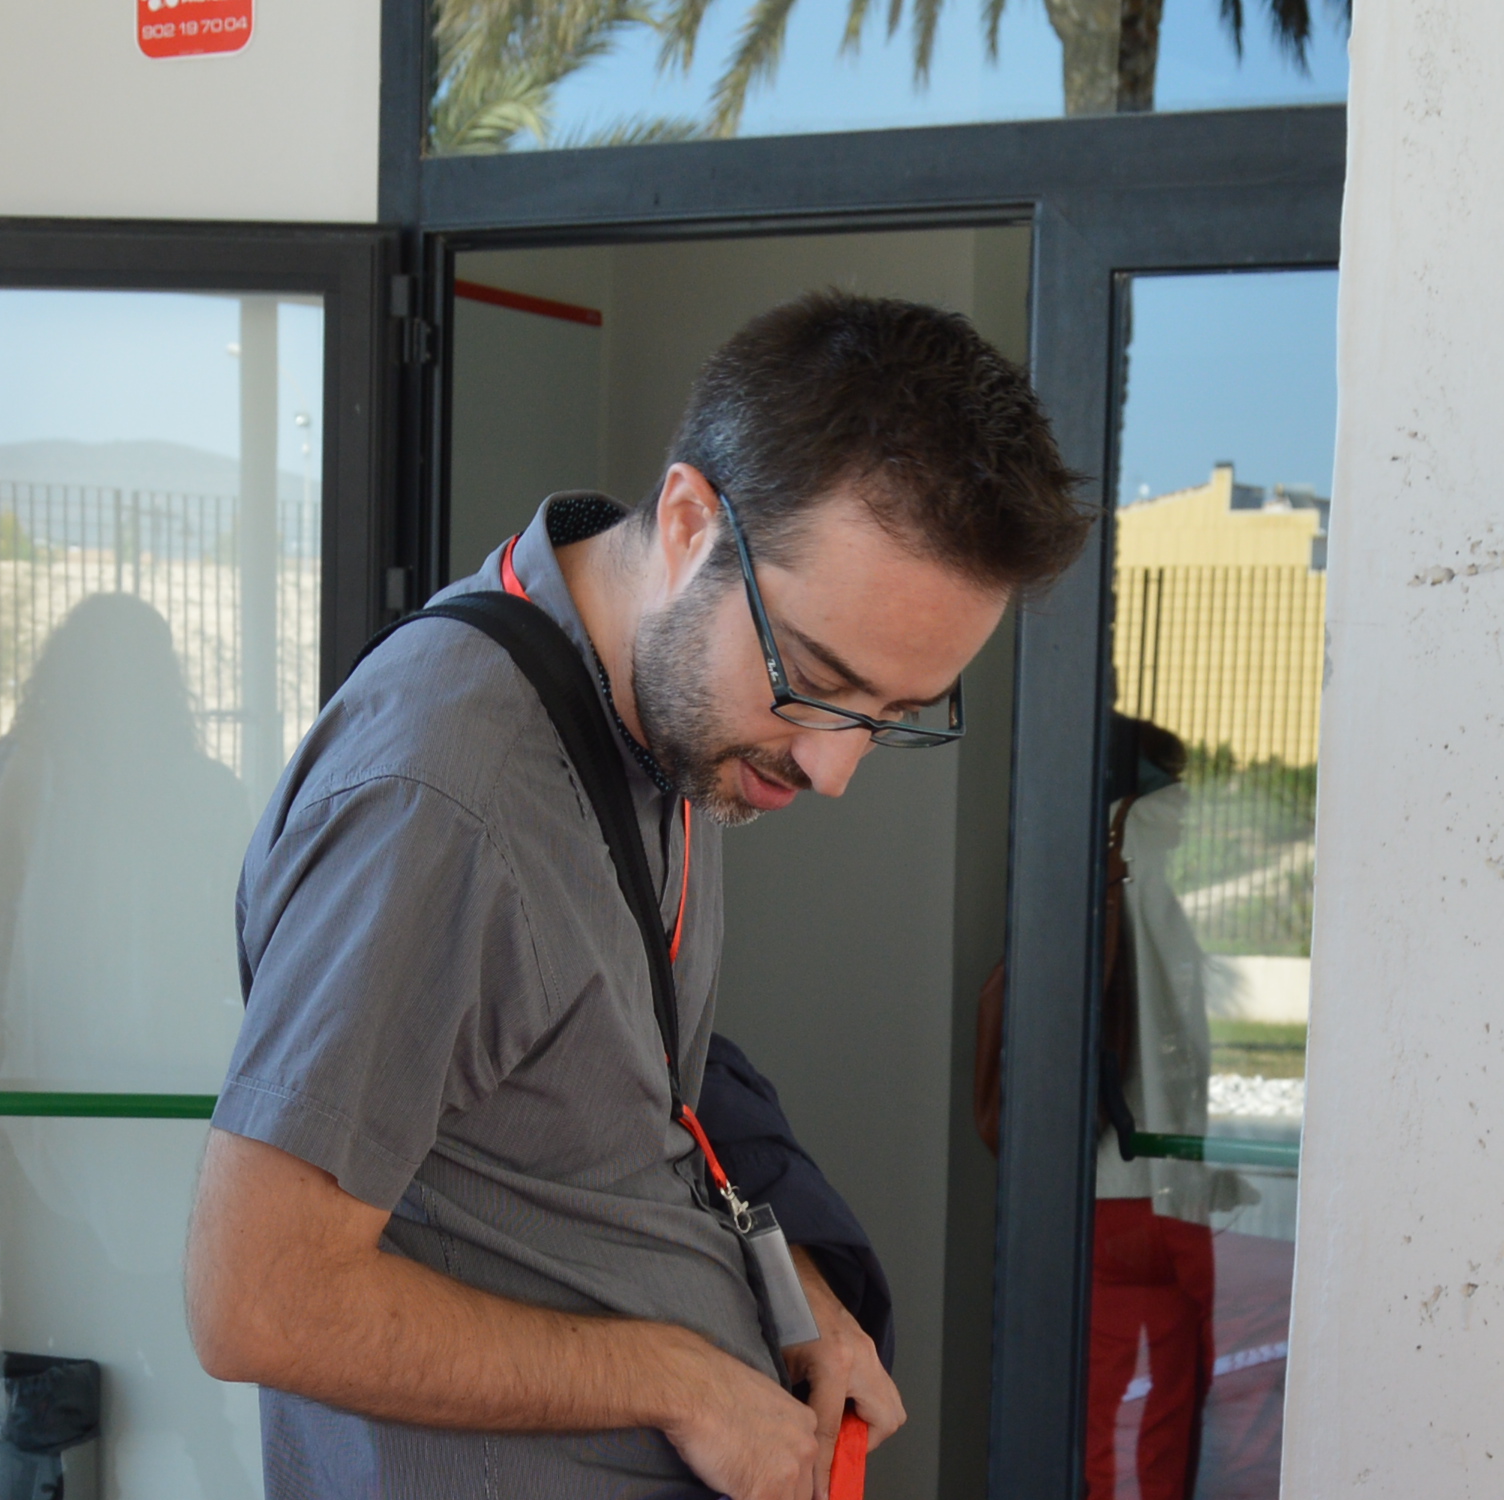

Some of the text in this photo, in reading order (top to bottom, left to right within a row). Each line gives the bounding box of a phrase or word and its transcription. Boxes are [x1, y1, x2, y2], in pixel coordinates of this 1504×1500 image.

[141, 22, 176, 40] 902
[200, 17, 223, 34] 70
[224, 15, 248, 32] 04
